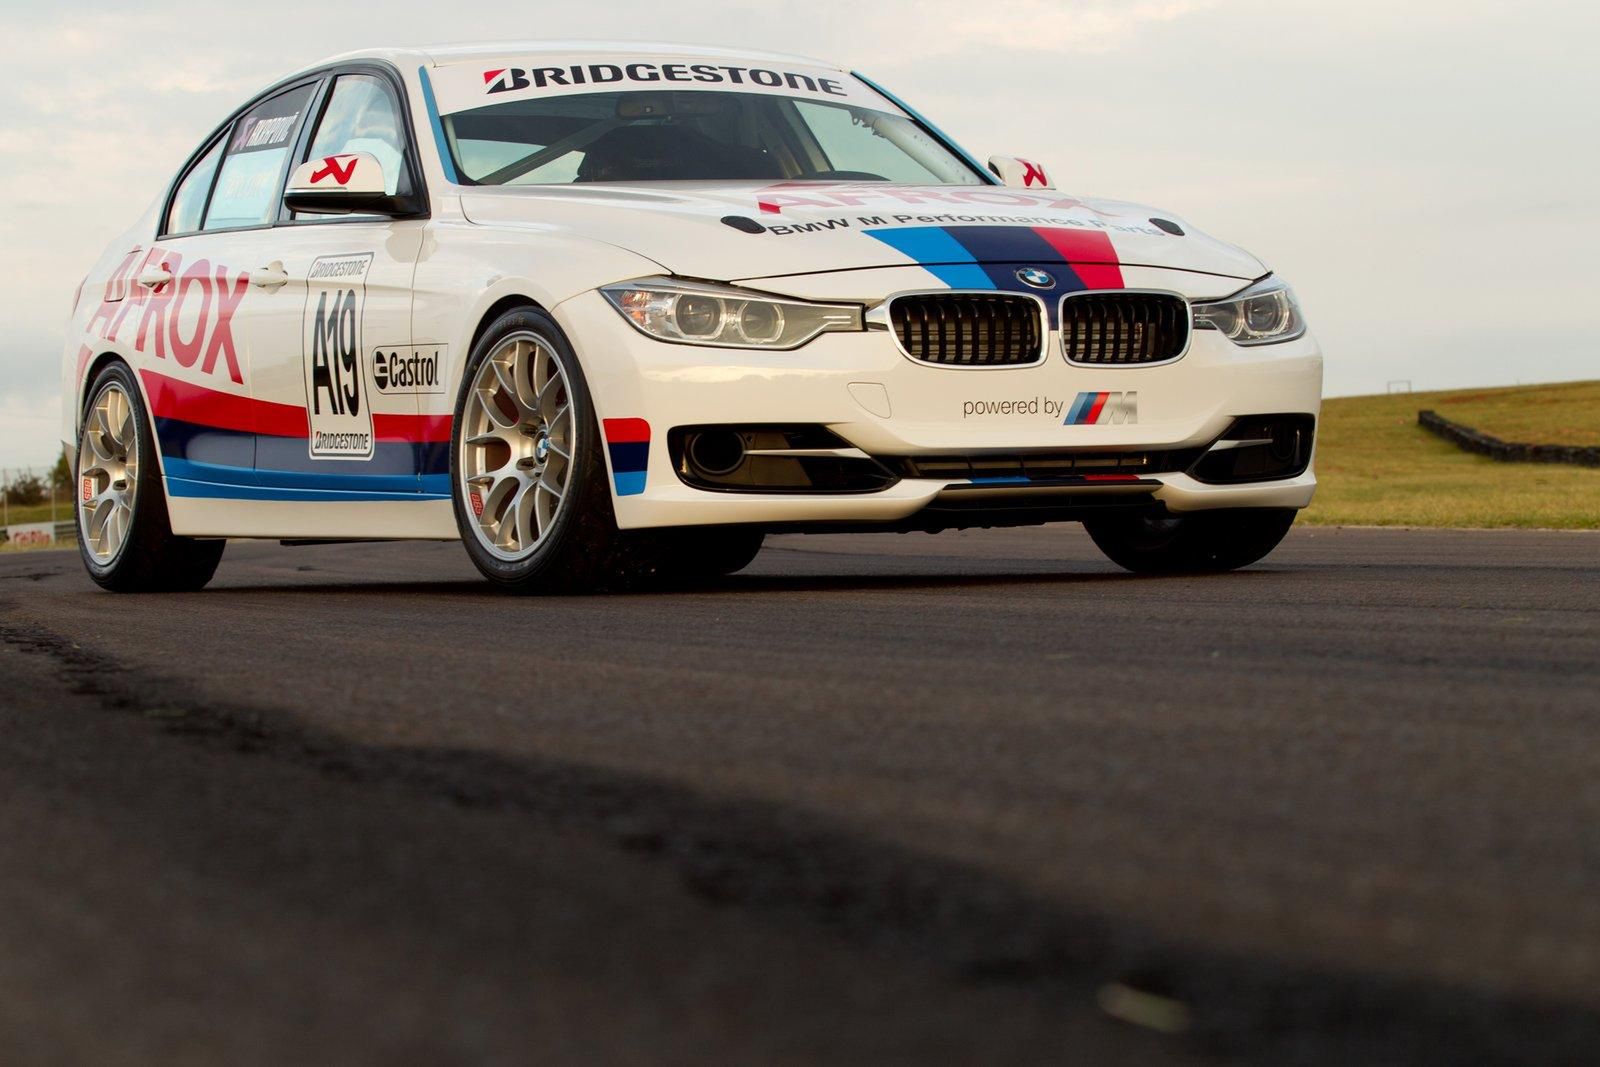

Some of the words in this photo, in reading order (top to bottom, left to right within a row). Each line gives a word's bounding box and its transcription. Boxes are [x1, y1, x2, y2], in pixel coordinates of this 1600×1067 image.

[483, 63, 849, 97] BRIDGESTONE
[767, 218, 850, 236] BMW
[857, 215, 888, 226] M
[892, 213, 1084, 227] Performance
[1088, 219, 1165, 236] Parts
[311, 259, 368, 279] BRIDGESTONE
[86, 245, 250, 385] AFROX
[313, 288, 360, 417] A19
[389, 350, 439, 388] Castrol
[963, 397, 1038, 418] powered
[1044, 397, 1064, 418] by
[315, 431, 369, 450] BRIDGESTONE
